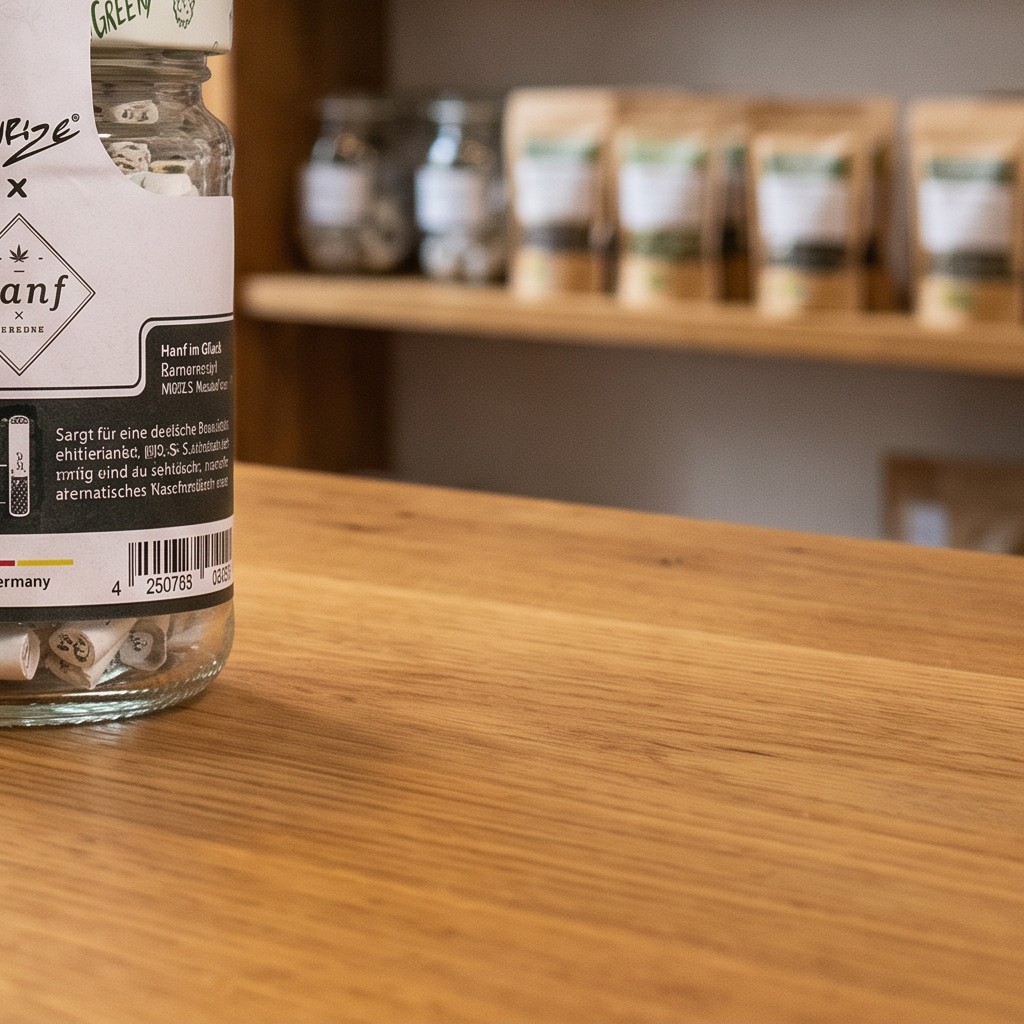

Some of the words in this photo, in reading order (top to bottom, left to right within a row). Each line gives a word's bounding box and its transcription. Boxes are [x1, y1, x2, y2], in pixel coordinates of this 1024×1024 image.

[161, 342, 188, 357] Hanf
[189, 343, 200, 356] im
[56, 427, 94, 445] Sargt
[97, 426, 116, 441] für
[119, 426, 147, 440] eine
[111, 580, 121, 596] 4
